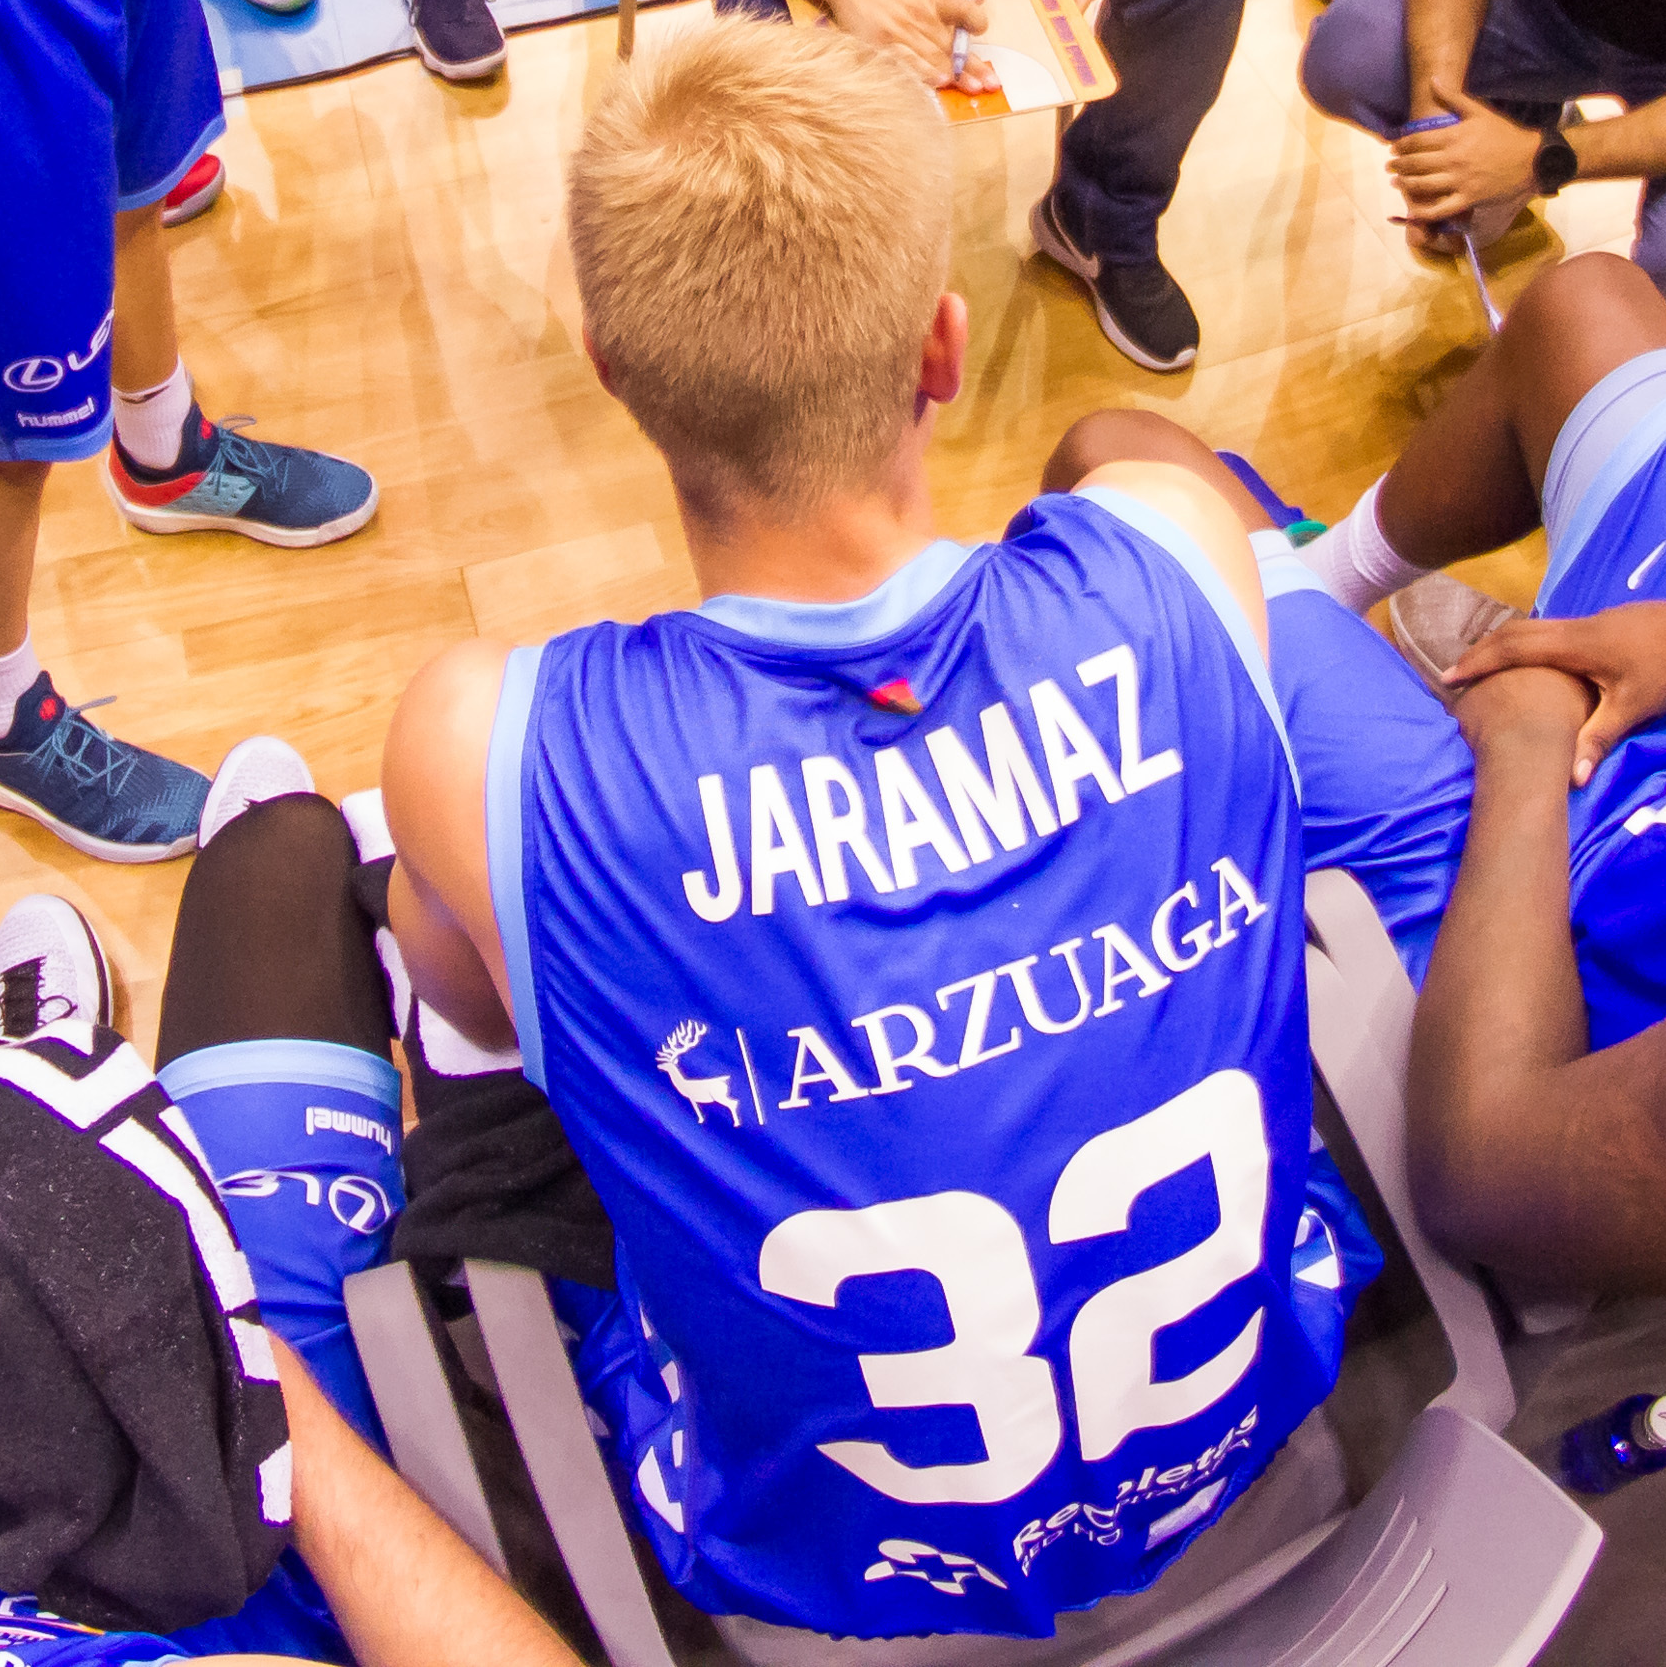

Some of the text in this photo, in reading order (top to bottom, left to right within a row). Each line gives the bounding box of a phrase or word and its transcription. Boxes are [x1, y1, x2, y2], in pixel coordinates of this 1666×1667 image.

[17, 397, 95, 428] hummel
[681, 643, 1184, 924] JARAMAZ
[778, 855, 1268, 1110] ARZUAGA
[305, 1106, 393, 1157] hummel
[759, 1068, 1270, 1505] 32
